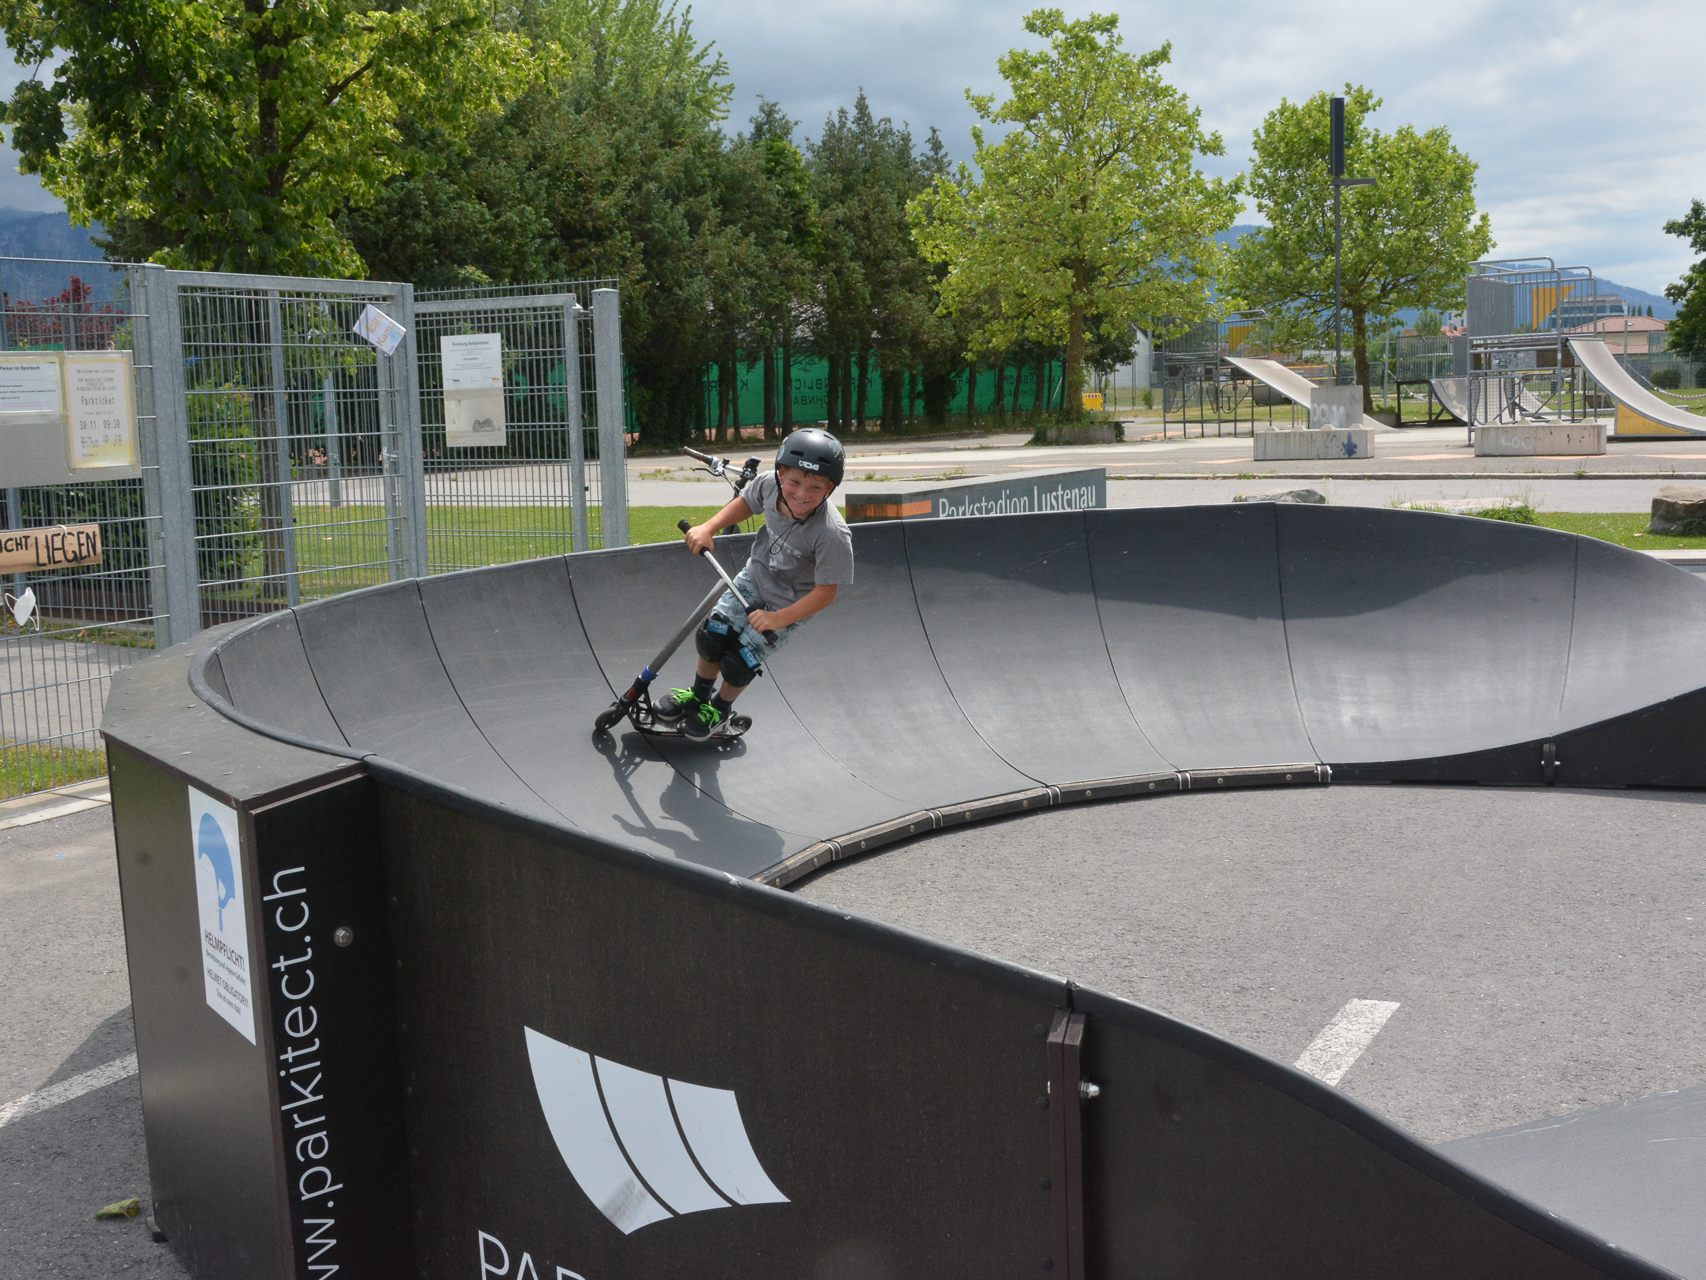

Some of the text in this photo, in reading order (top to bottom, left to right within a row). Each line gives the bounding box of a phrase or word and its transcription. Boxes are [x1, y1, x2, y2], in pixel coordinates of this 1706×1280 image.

[80, 395, 115, 406] Parkticket
[939, 484, 1096, 518] Parkstadion Lustenau
[35, 530, 97, 567] LIEGEN
